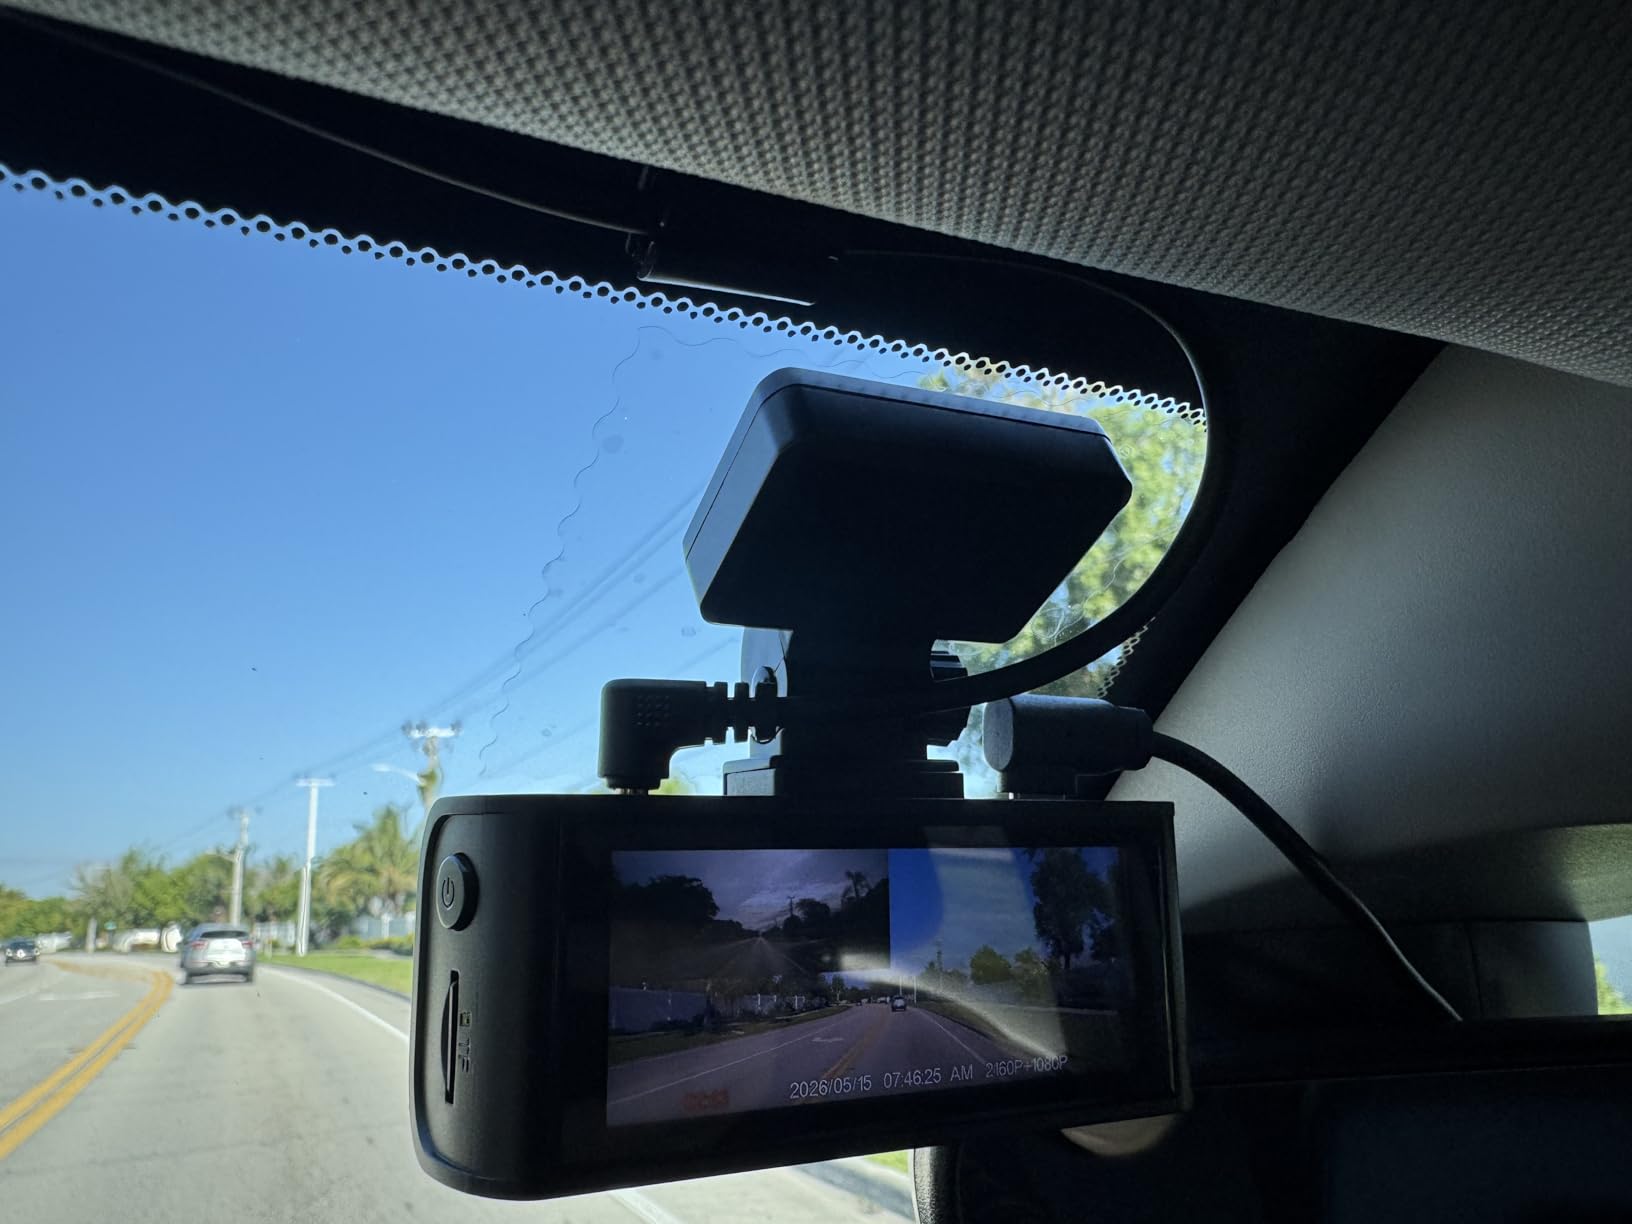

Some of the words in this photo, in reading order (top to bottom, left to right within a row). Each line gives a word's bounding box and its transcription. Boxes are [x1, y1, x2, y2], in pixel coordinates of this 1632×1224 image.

[790, 1075, 872, 1099] 2026/05/15
[884, 1068, 942, 1089] 07:46:25
[950, 1064, 973, 1082] AM
[985, 1055, 1068, 1078] 2160P+1080P
